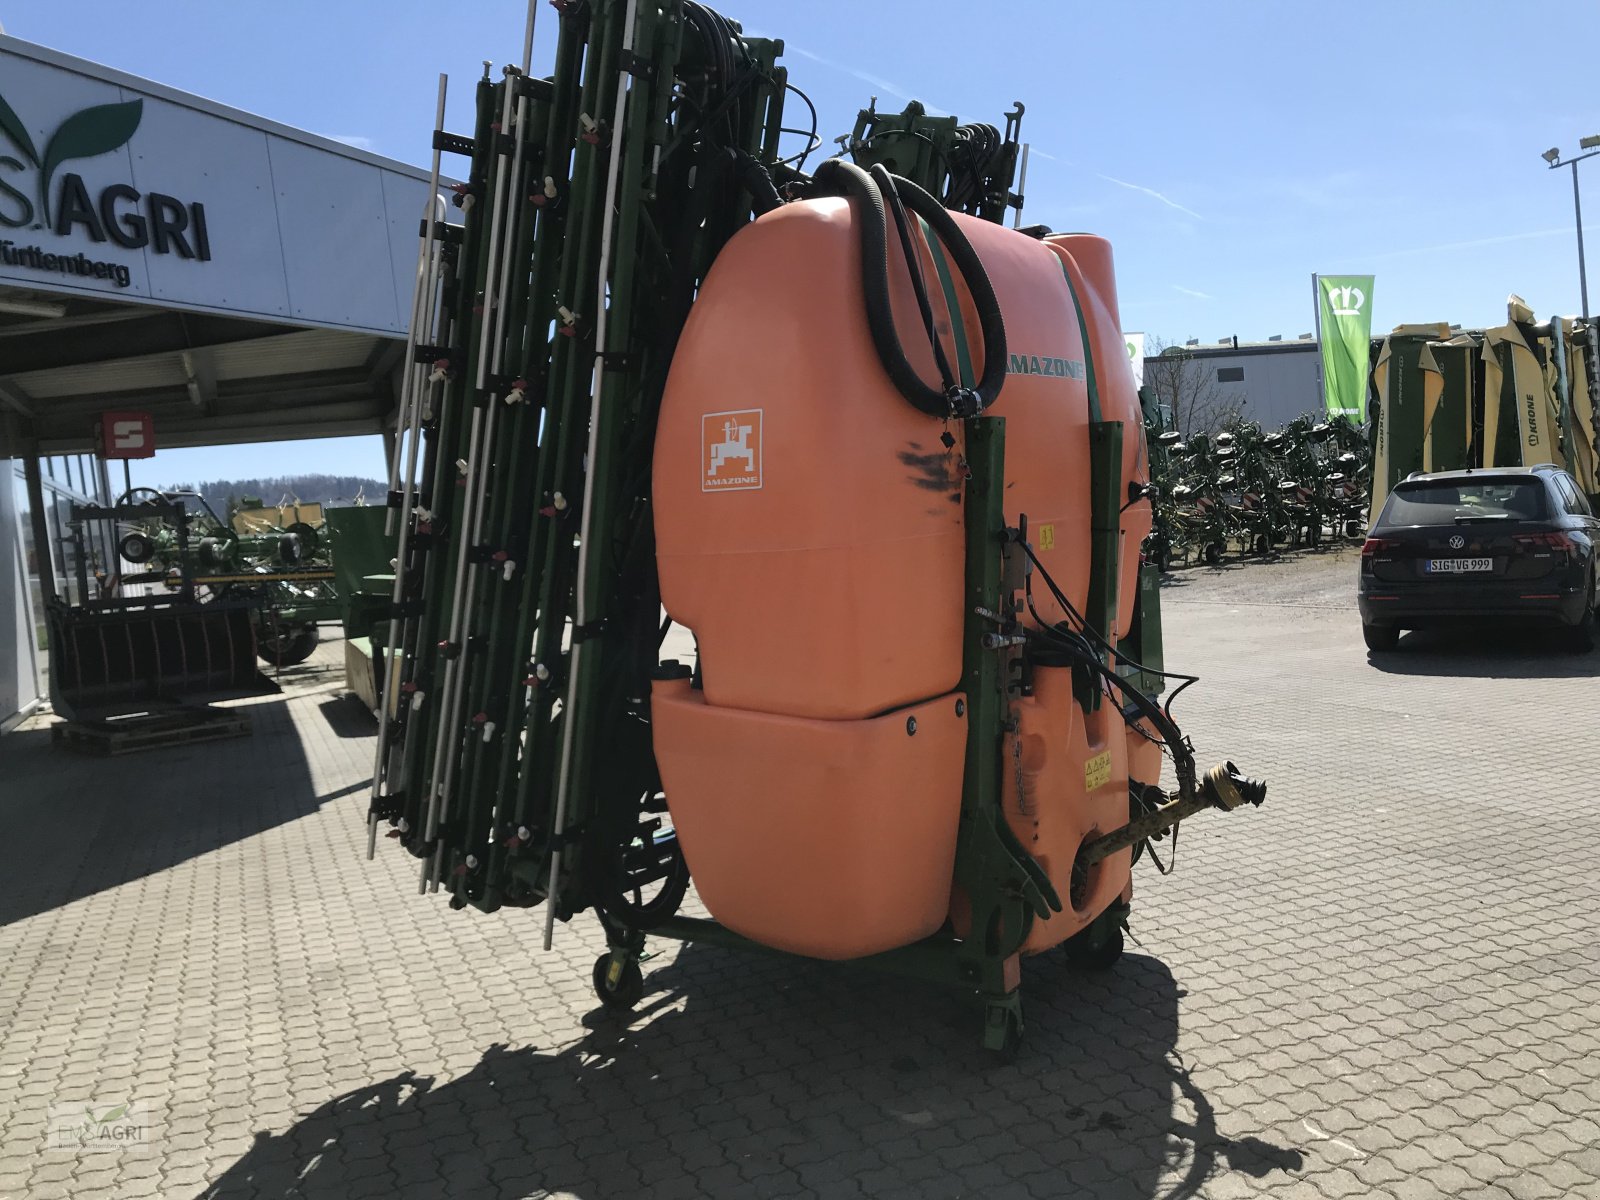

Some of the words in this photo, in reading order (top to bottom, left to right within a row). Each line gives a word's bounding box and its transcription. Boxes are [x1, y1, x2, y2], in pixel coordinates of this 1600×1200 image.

[56, 172, 211, 262] AGRI
[0, 239, 131, 288] ürttemberg
[1525, 394, 1538, 433] KRONE
[704, 475, 758, 486] AMAZONE
[1432, 559, 1449, 570] SIG
[1456, 559, 1469, 570] VG
[1471, 559, 1490, 570] 999
